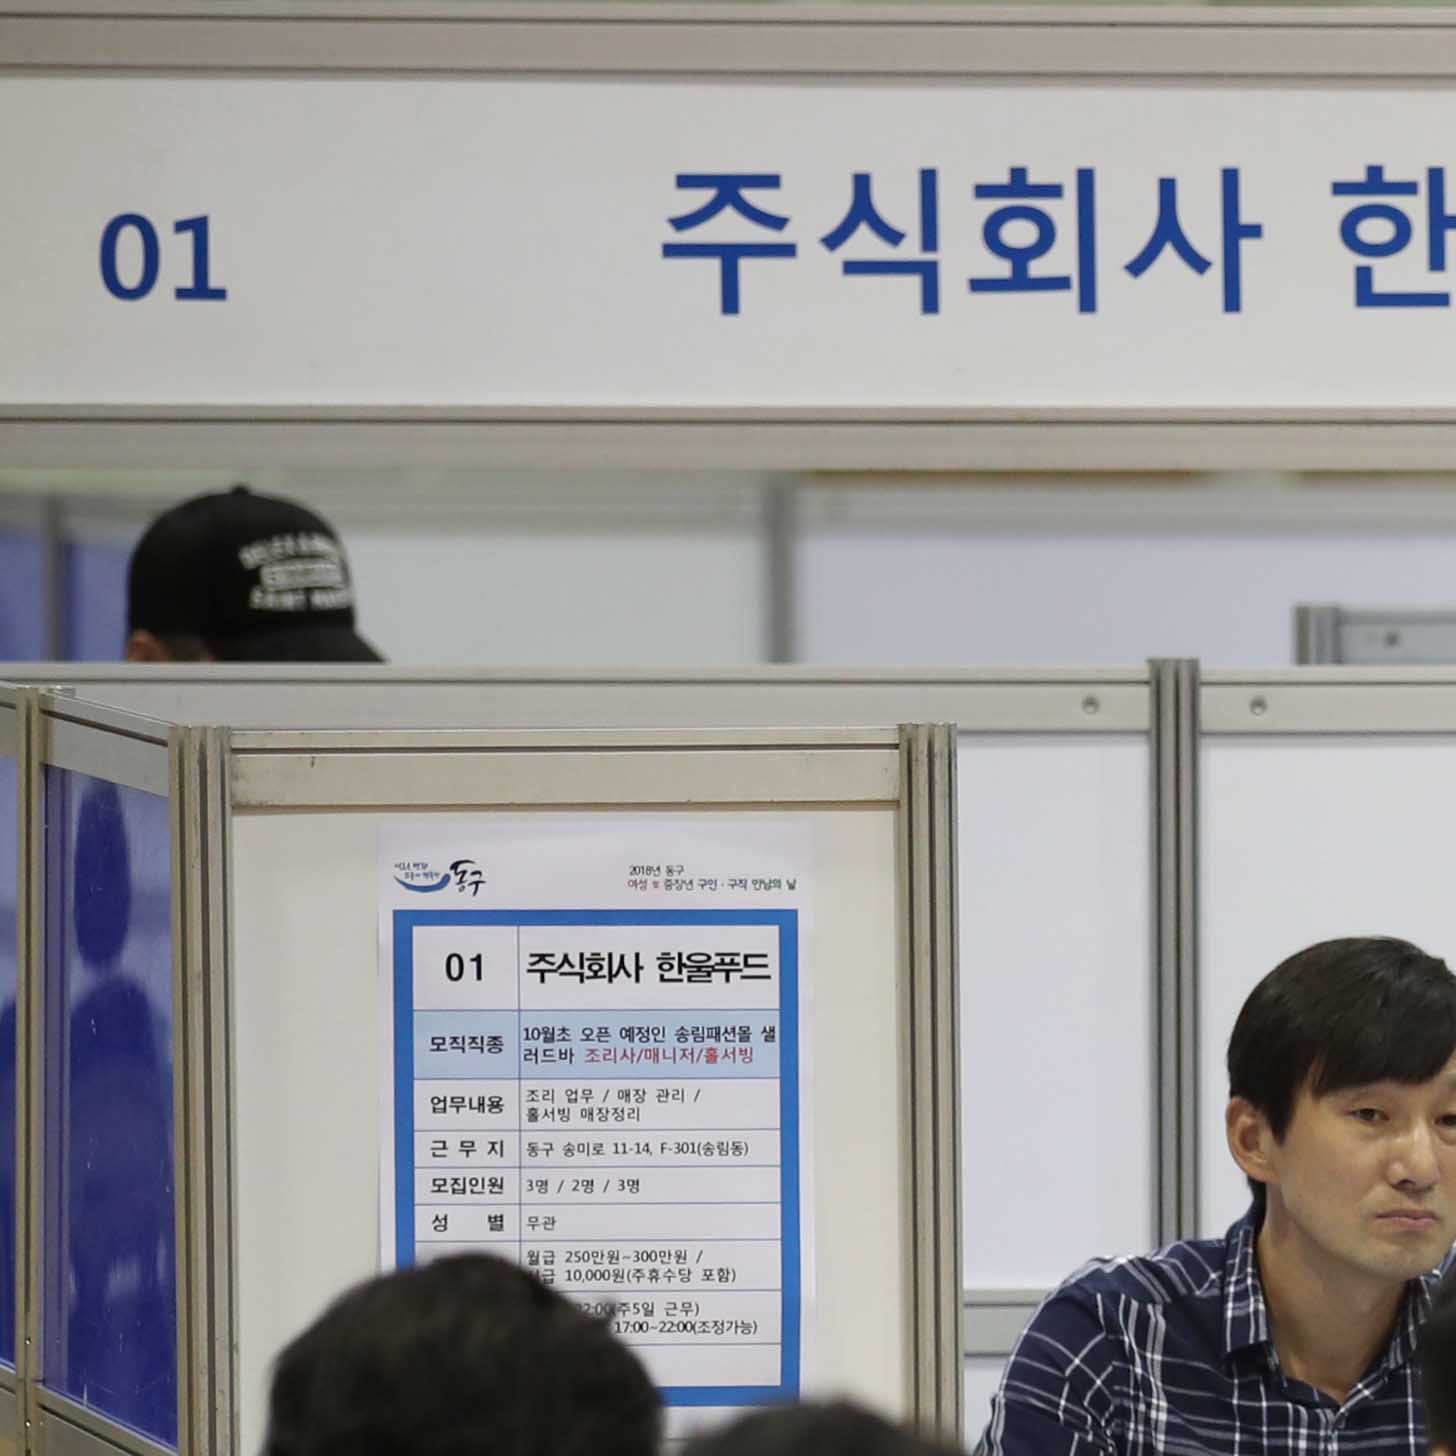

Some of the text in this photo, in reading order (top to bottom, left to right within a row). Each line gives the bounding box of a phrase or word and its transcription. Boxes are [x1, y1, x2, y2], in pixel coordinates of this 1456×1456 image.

[662, 165, 1262, 317] 주식회사
[98, 210, 229, 306] 01
[629, 865, 660, 877] 2018년
[445, 953, 483, 982] 01
[527, 951, 771, 984] 주식회사 한울푸드
[523, 1026, 572, 1042] 10월초
[580, 1026, 611, 1042] 오픈
[620, 1026, 665, 1042] 예정인
[675, 1026, 754, 1042] 송림패션몰
[523, 1047, 753, 1064] 러드바 조리사/매니저/홀서빙
[526, 1089, 700, 1103] 조리 업무 / 매장 관리 /
[431, 1096, 504, 1114] 업무내용
[526, 1107, 640, 1123] 홀서빙 매장정리
[430, 1140, 504, 1158] 근 무 지
[526, 1141, 749, 1158] 동구 송미로 11-14, F-301(송림동)
[430, 1177, 505, 1195] 모집인원
[527, 1178, 640, 1194] 3명 / 2명 / 3명
[526, 1216, 556, 1231] 무관
[565, 1250, 687, 1265] 250만원~300만원
[696, 1250, 703, 1263] /
[566, 1268, 691, 1284] 10,000원(주휴수당
[701, 1269, 736, 1284] 포함)
[664, 1303, 699, 1317] 근무)
